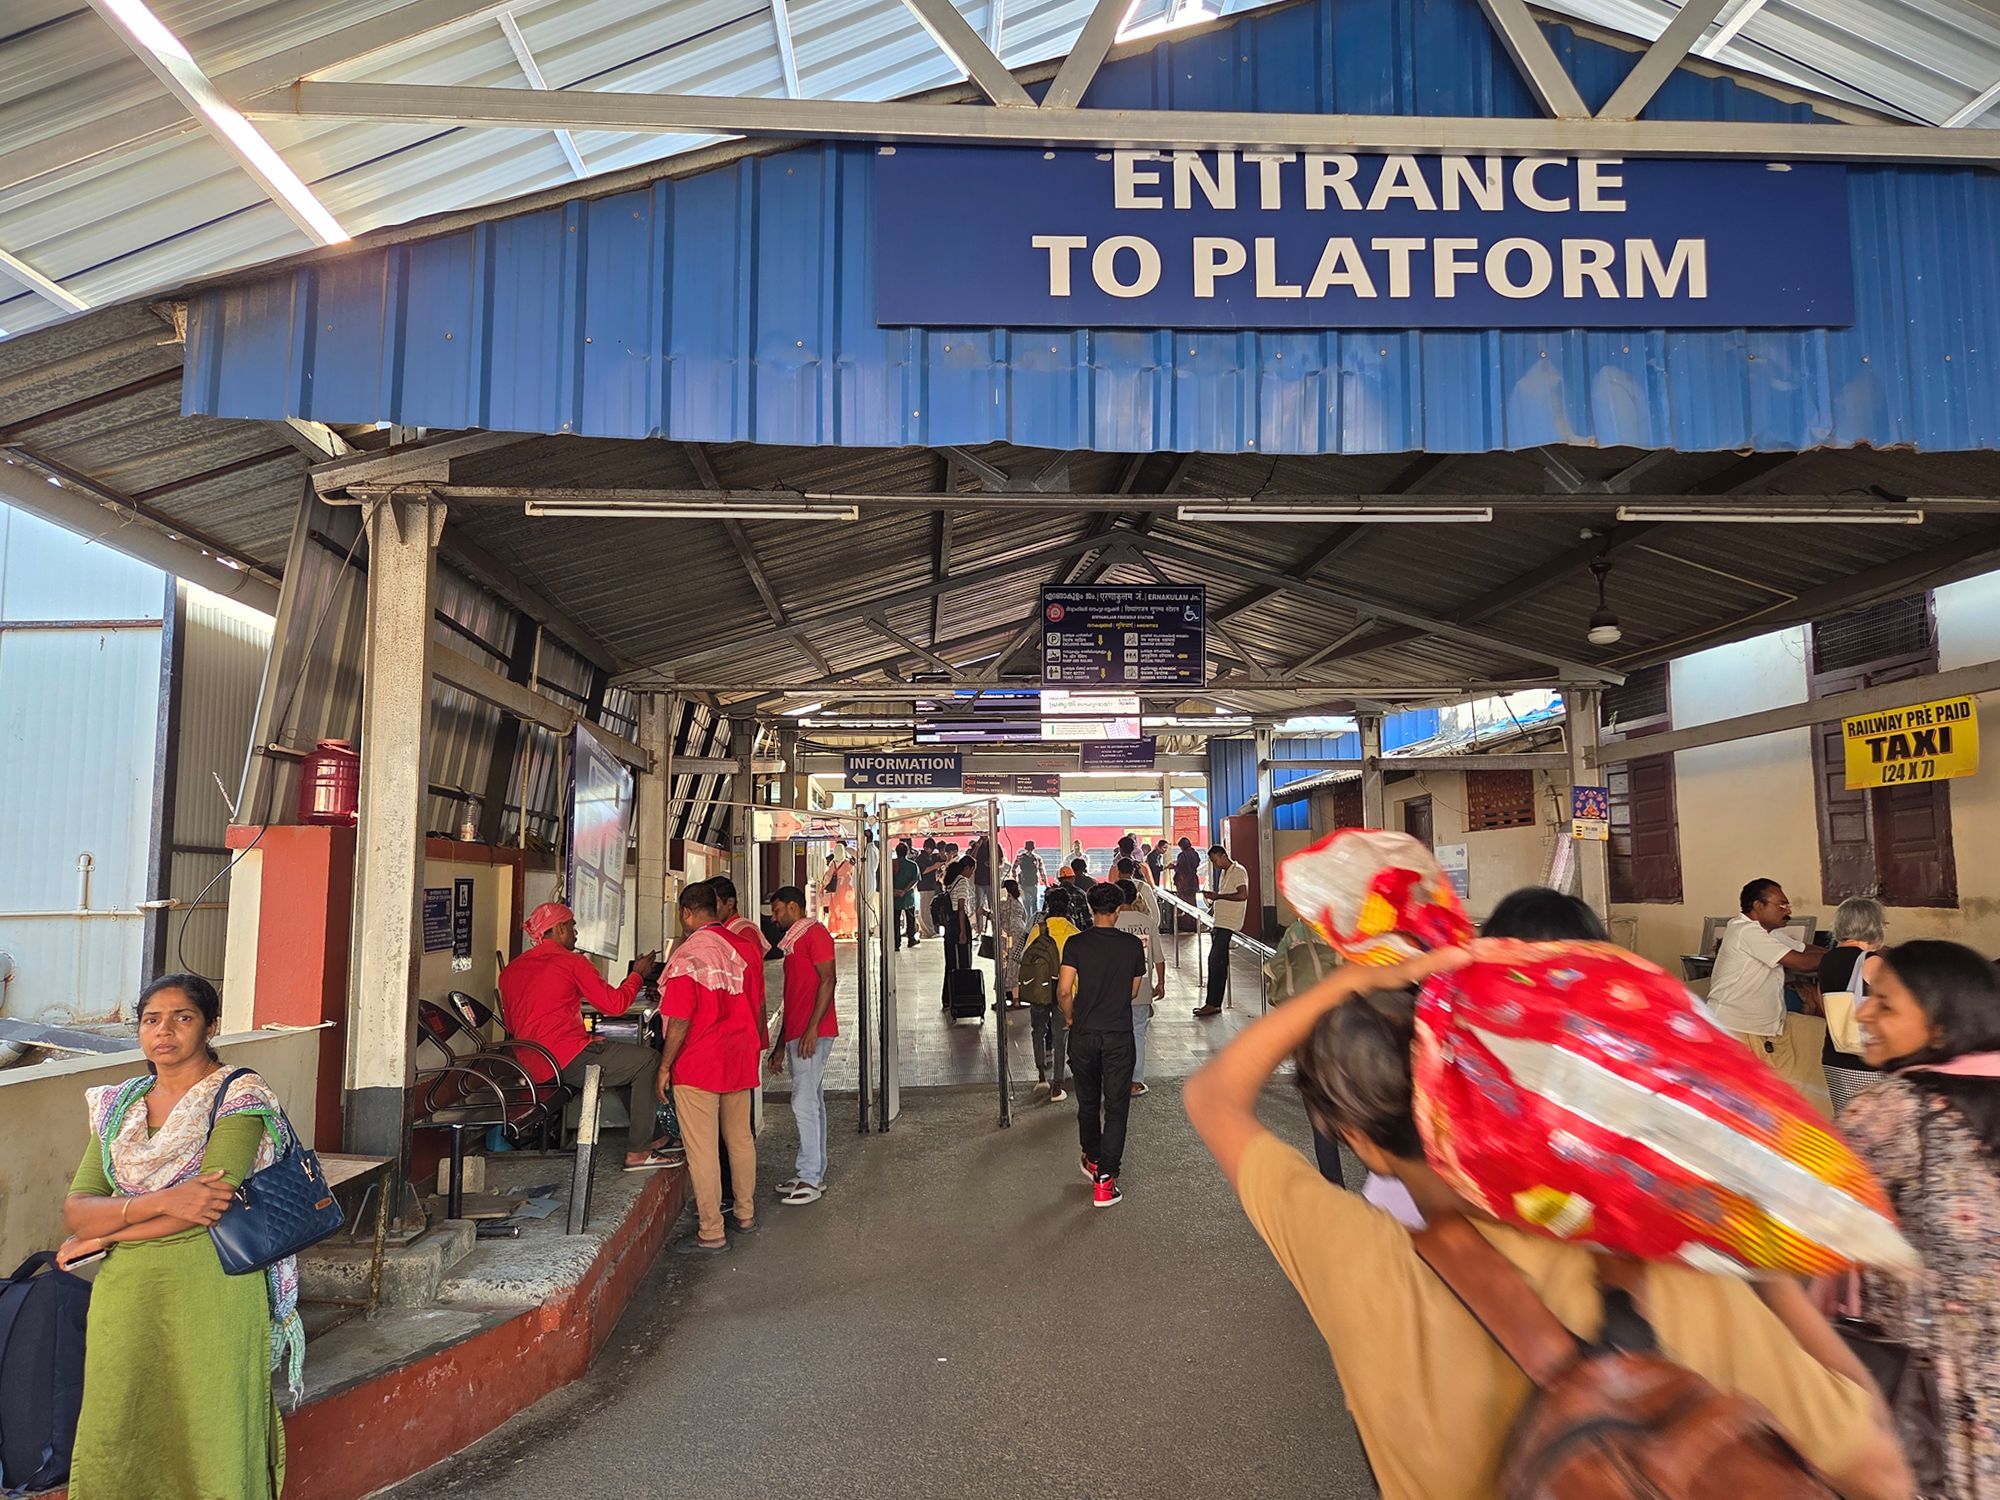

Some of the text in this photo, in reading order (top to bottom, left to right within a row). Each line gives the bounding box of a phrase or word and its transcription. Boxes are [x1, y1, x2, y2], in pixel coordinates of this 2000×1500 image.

[1113, 150, 1628, 213] ENTRANCE
[1032, 235, 1708, 300] TO PLATFORM
[1147, 593, 1189, 601] ERNAKULAM
[1847, 701, 1971, 738] RAILWAY PRE PAID
[1865, 726, 1953, 764] TAXI
[849, 757, 955, 770] INFORMATION
[1908, 762, 1918, 780] X
[875, 773, 933, 785] CENTRE
